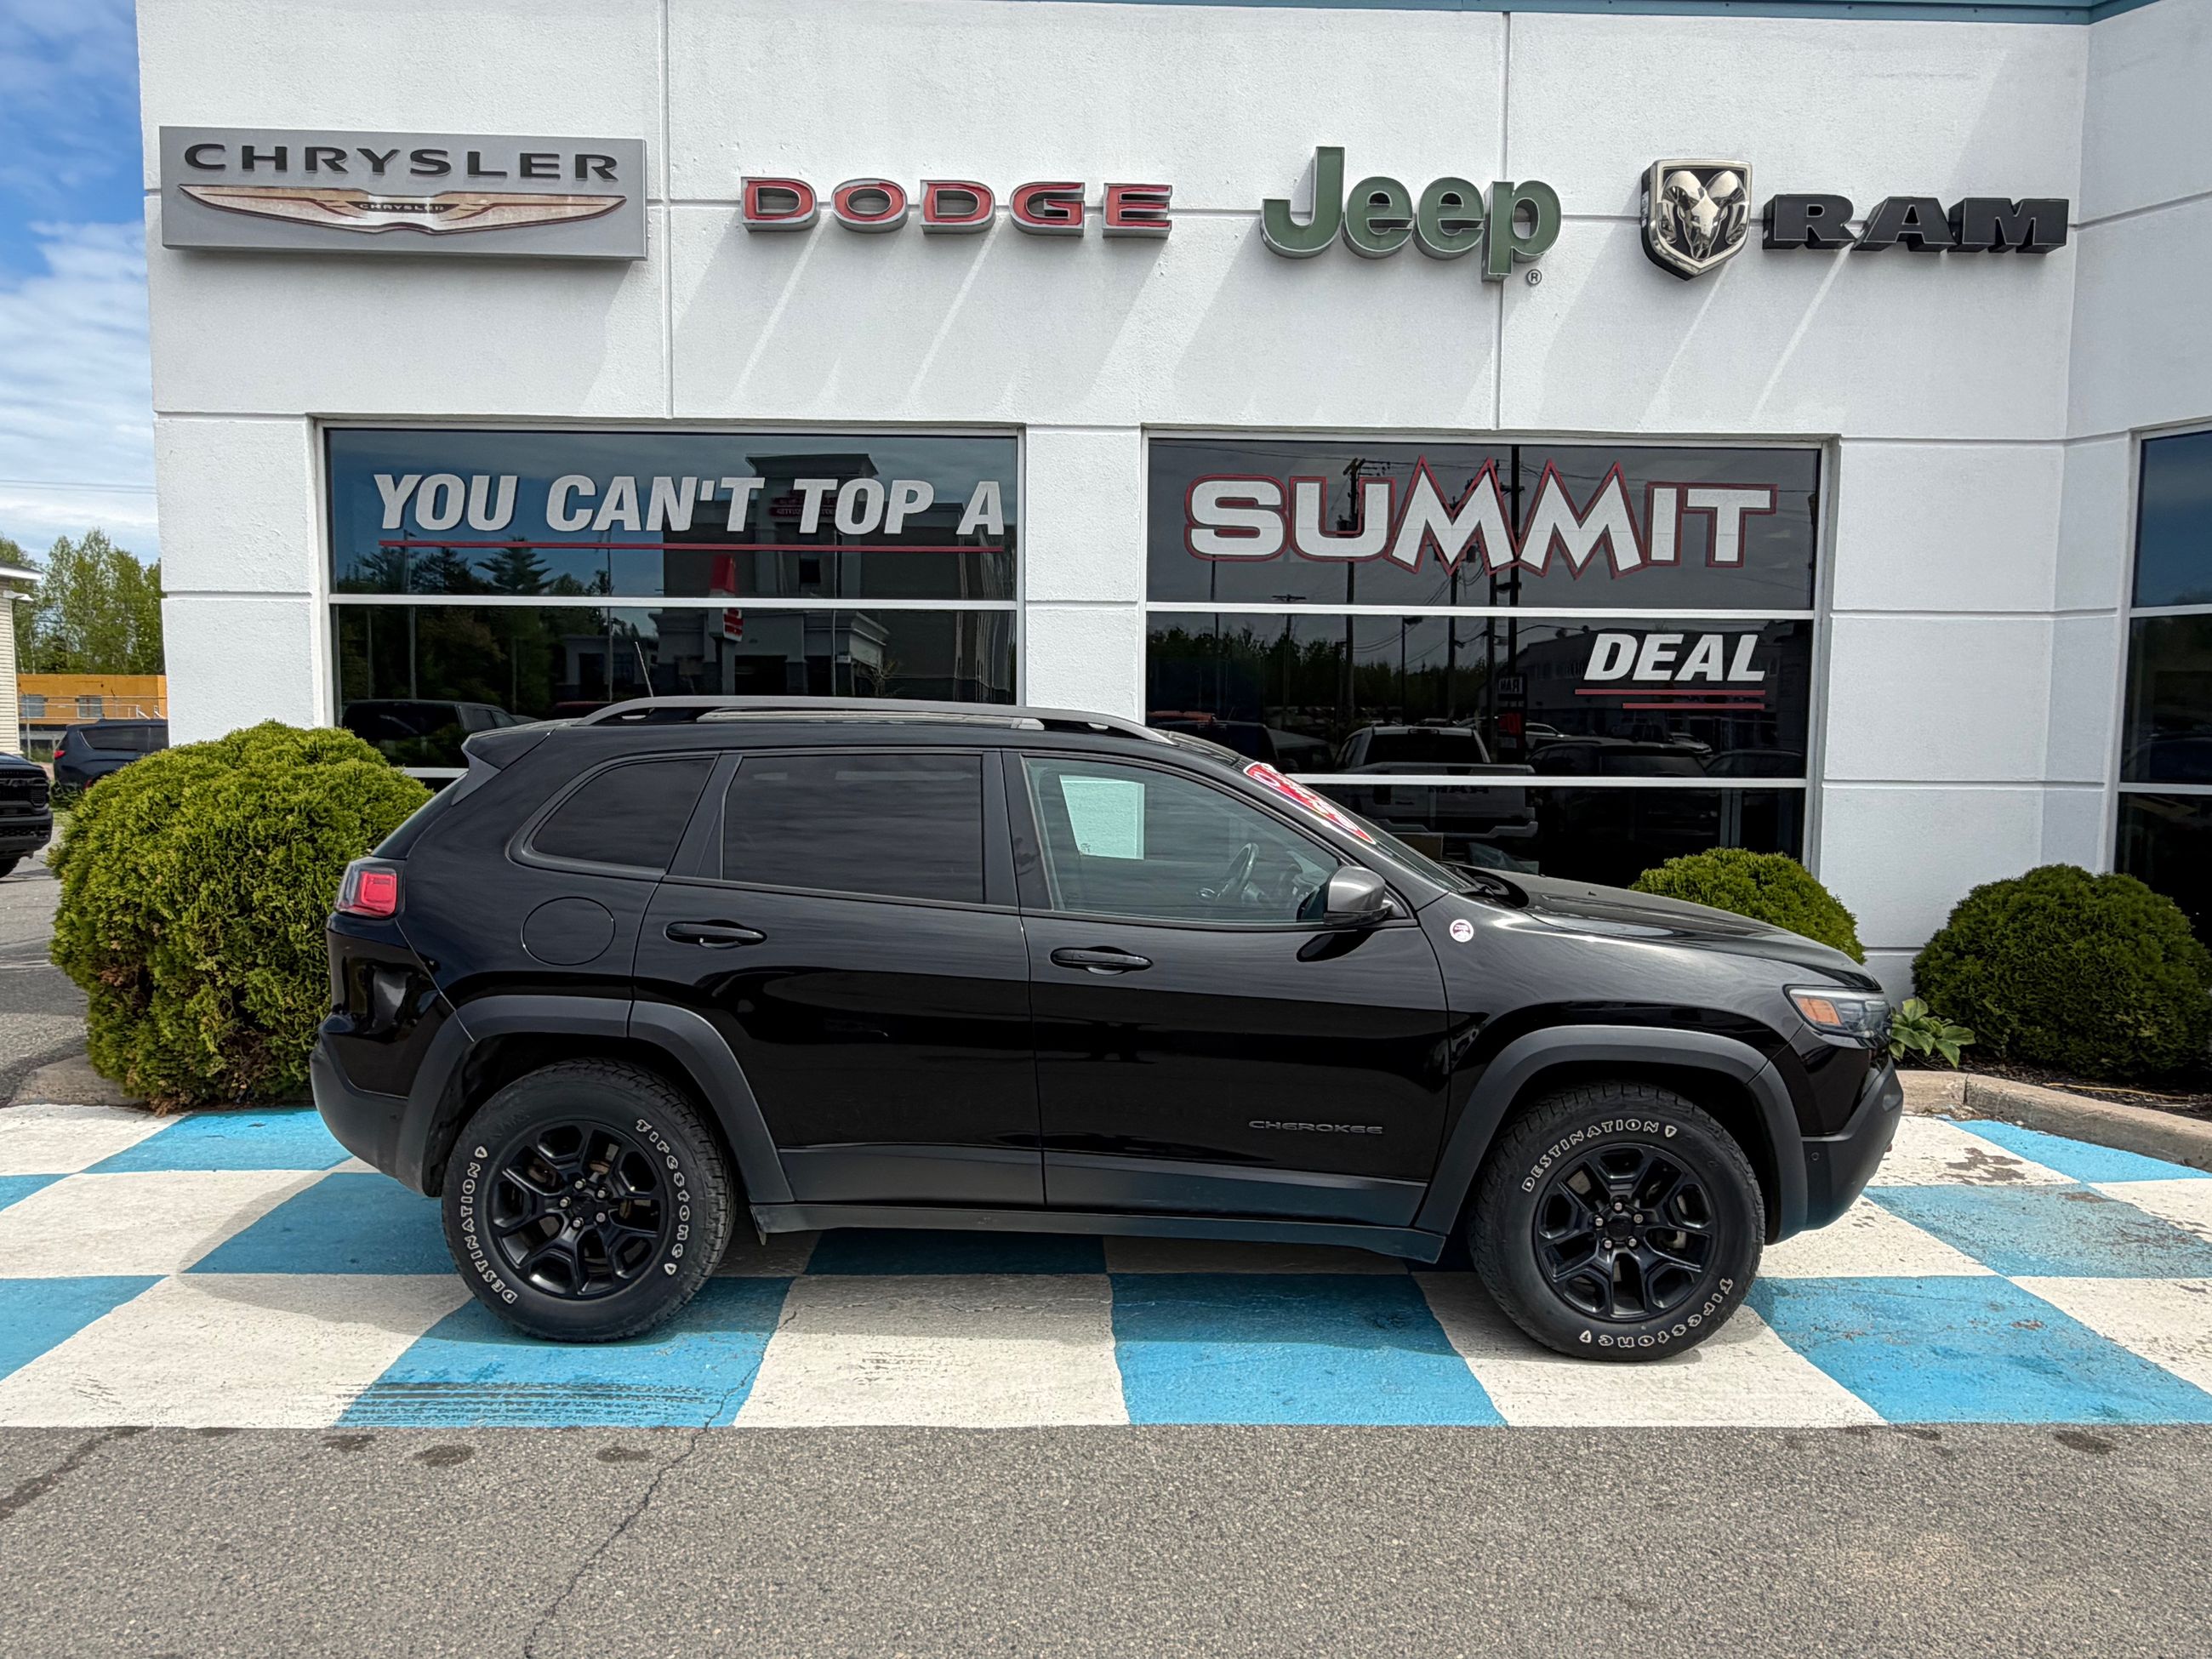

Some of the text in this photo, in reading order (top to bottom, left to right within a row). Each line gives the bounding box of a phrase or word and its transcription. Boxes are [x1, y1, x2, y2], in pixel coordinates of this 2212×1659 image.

[184, 143, 619, 181] CHRYSLER
[741, 176, 1172, 239] DODGE
[1260, 146, 1561, 282] Jeep
[1763, 193, 2069, 253] RAM
[373, 474, 1005, 536] YOU CAN'T TOP A
[1184, 454, 1778, 580] SUMMIT
[1582, 633, 1766, 682] DEAL
[1248, 1120, 1383, 1134] CHEROKEE
[1521, 1119, 1660, 1193] DESTINATION
[460, 1162, 518, 1304] DESTINATION
